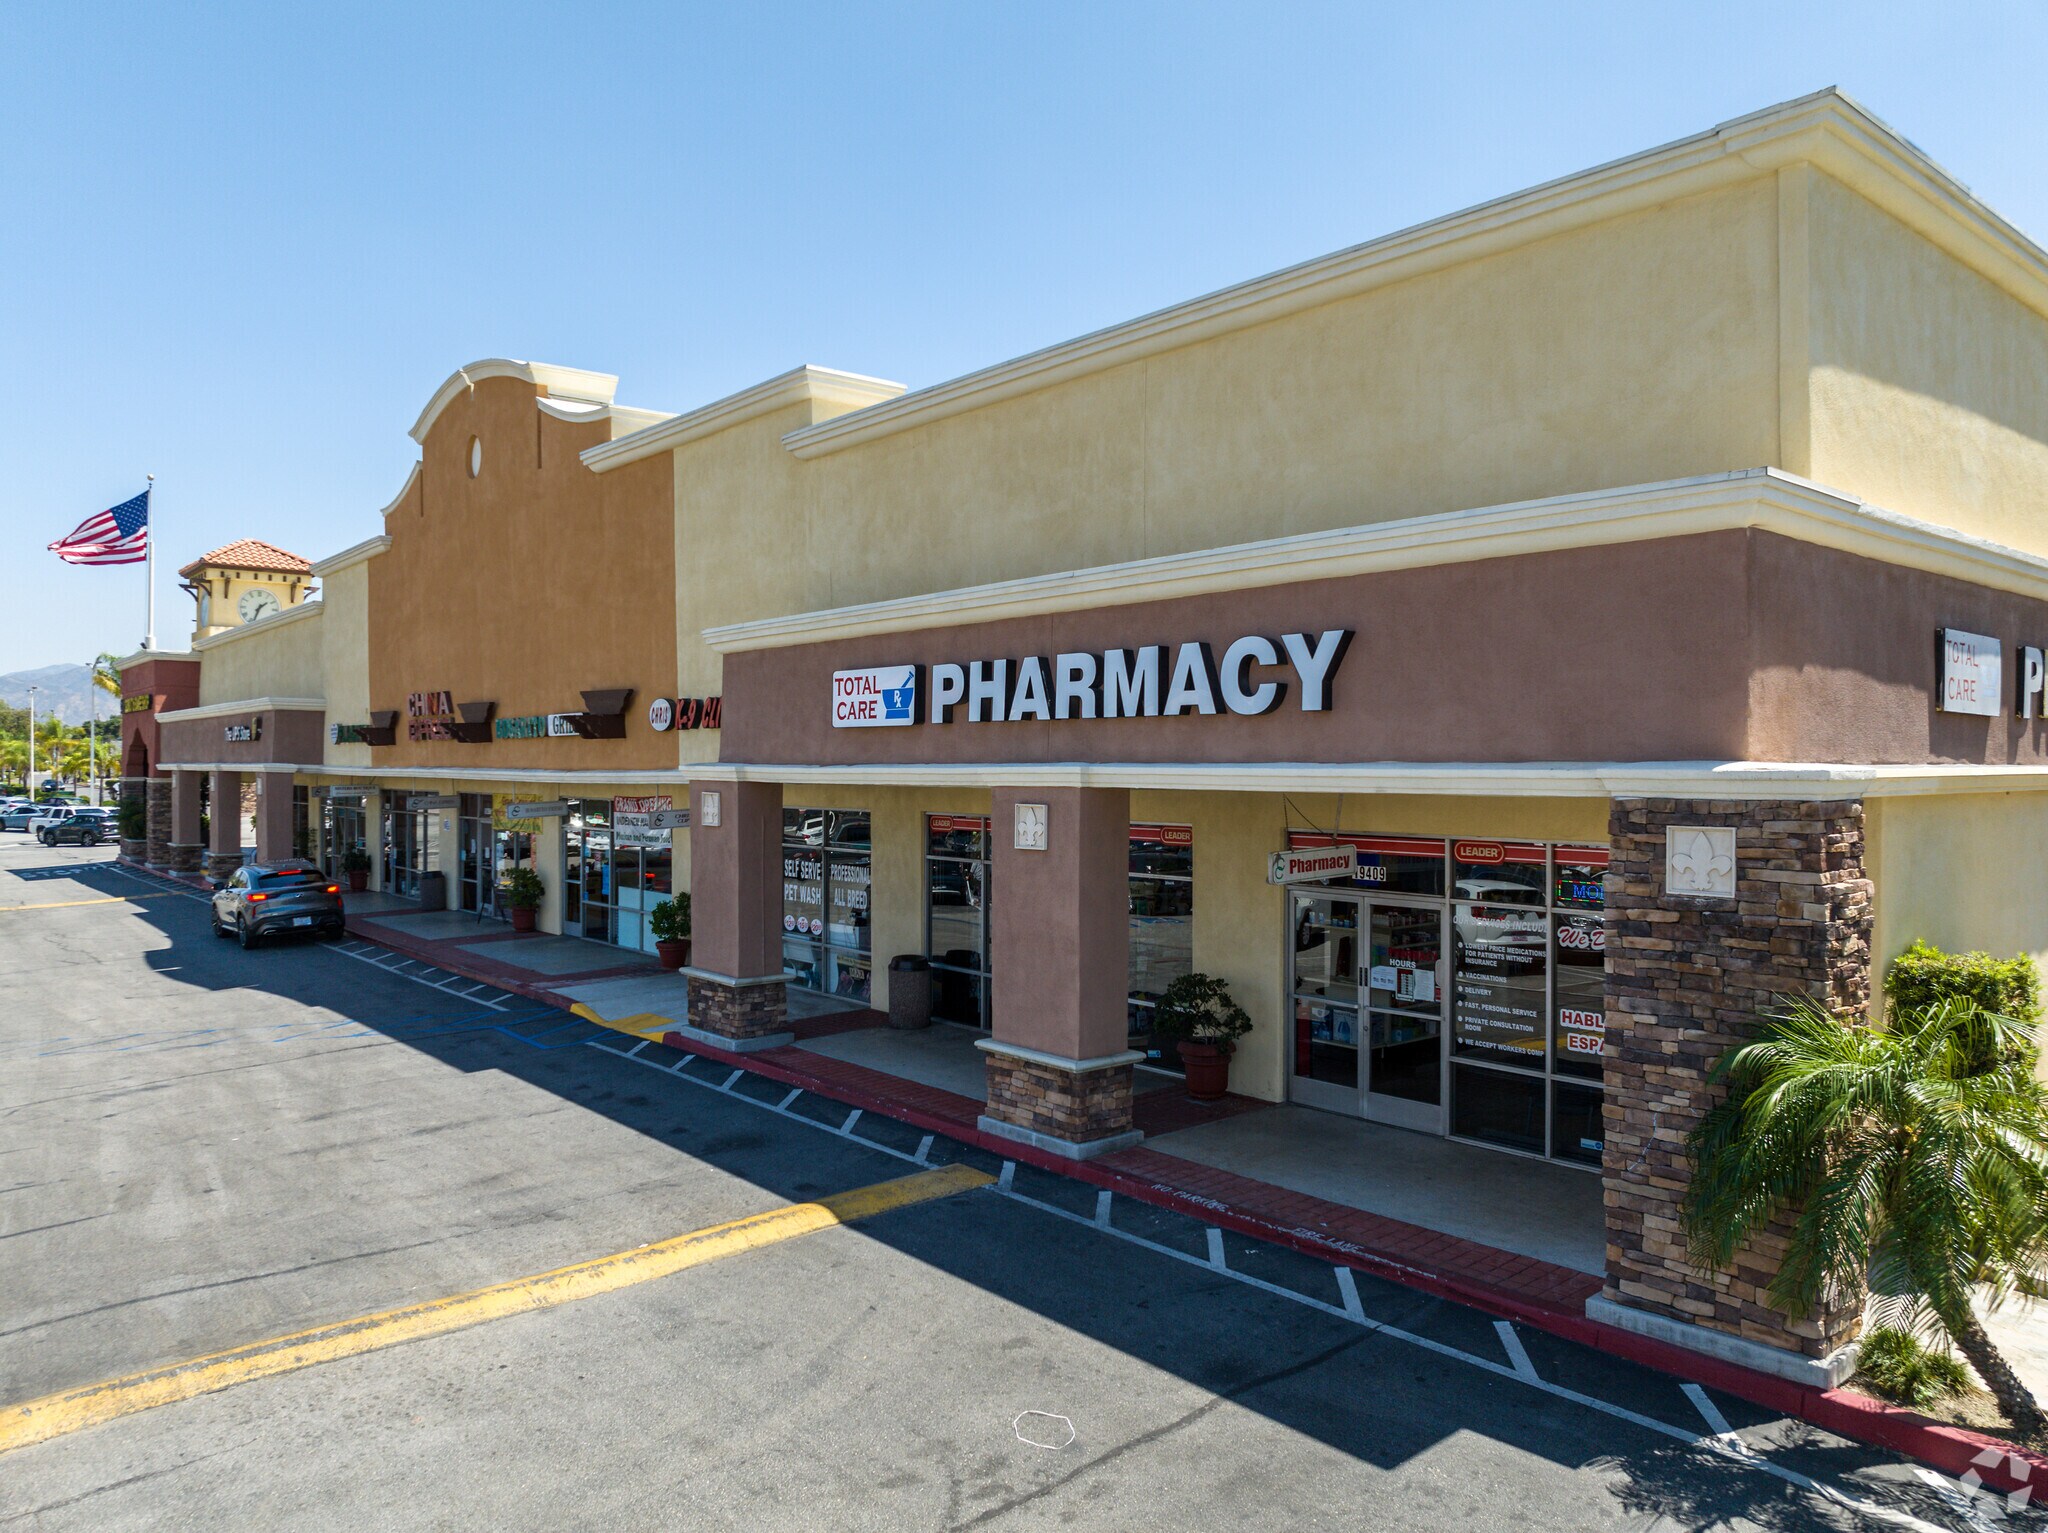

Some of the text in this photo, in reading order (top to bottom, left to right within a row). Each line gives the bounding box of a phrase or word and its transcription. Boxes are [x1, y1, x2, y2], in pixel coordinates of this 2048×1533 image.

[1946, 640, 1979, 667] TOTAL
[932, 629, 1351, 724] PHARMACY
[834, 675, 882, 698] TOTAL
[1948, 676, 1976, 702] CARE
[407, 690, 451, 717] CHINA
[836, 700, 878, 721] CARE
[615, 796, 672, 813] GRAND OPENING
[932, 819, 951, 827] LEADER
[1164, 831, 1191, 840] LEADER
[1460, 846, 1498, 857] LEADER
[784, 859, 821, 880] SELF SERVE
[1289, 854, 1351, 875] Pharmacy
[830, 864, 871, 885] PROFESSIONAL
[1355, 866, 1385, 881] 19409
[784, 883, 821, 905] PET WASH
[834, 887, 868, 909] ALL BREED
[1453, 915, 1469, 925] OUR
[1471, 917, 1510, 930] SERVICES
[1559, 928, 1586, 945] We
[1465, 942, 1546, 957] LOWEST PRICE MEDICATIONS
[1477, 951, 1505, 960] PATIENTS
[1506, 955, 1533, 964] WITHOUT
[1389, 958, 1417, 969] HOURS
[1465, 957, 1498, 967] INSURANCE
[1465, 971, 1508, 983] VACCINATIONS
[1464, 986, 1492, 996] DELIVERY
[1464, 1001, 1538, 1018] FAST, PERSONAL SERVICE
[1464, 1016, 1534, 1032] PRIVATE CONSULTATION
[1464, 1024, 1481, 1032] ROOM
[1464, 1038, 1545, 1057] WE ACCEPT WORKERS COMP
[1151, 1182, 1230, 1212] NO PARKING
[1290, 1227, 1365, 1253] FIRE LANE
